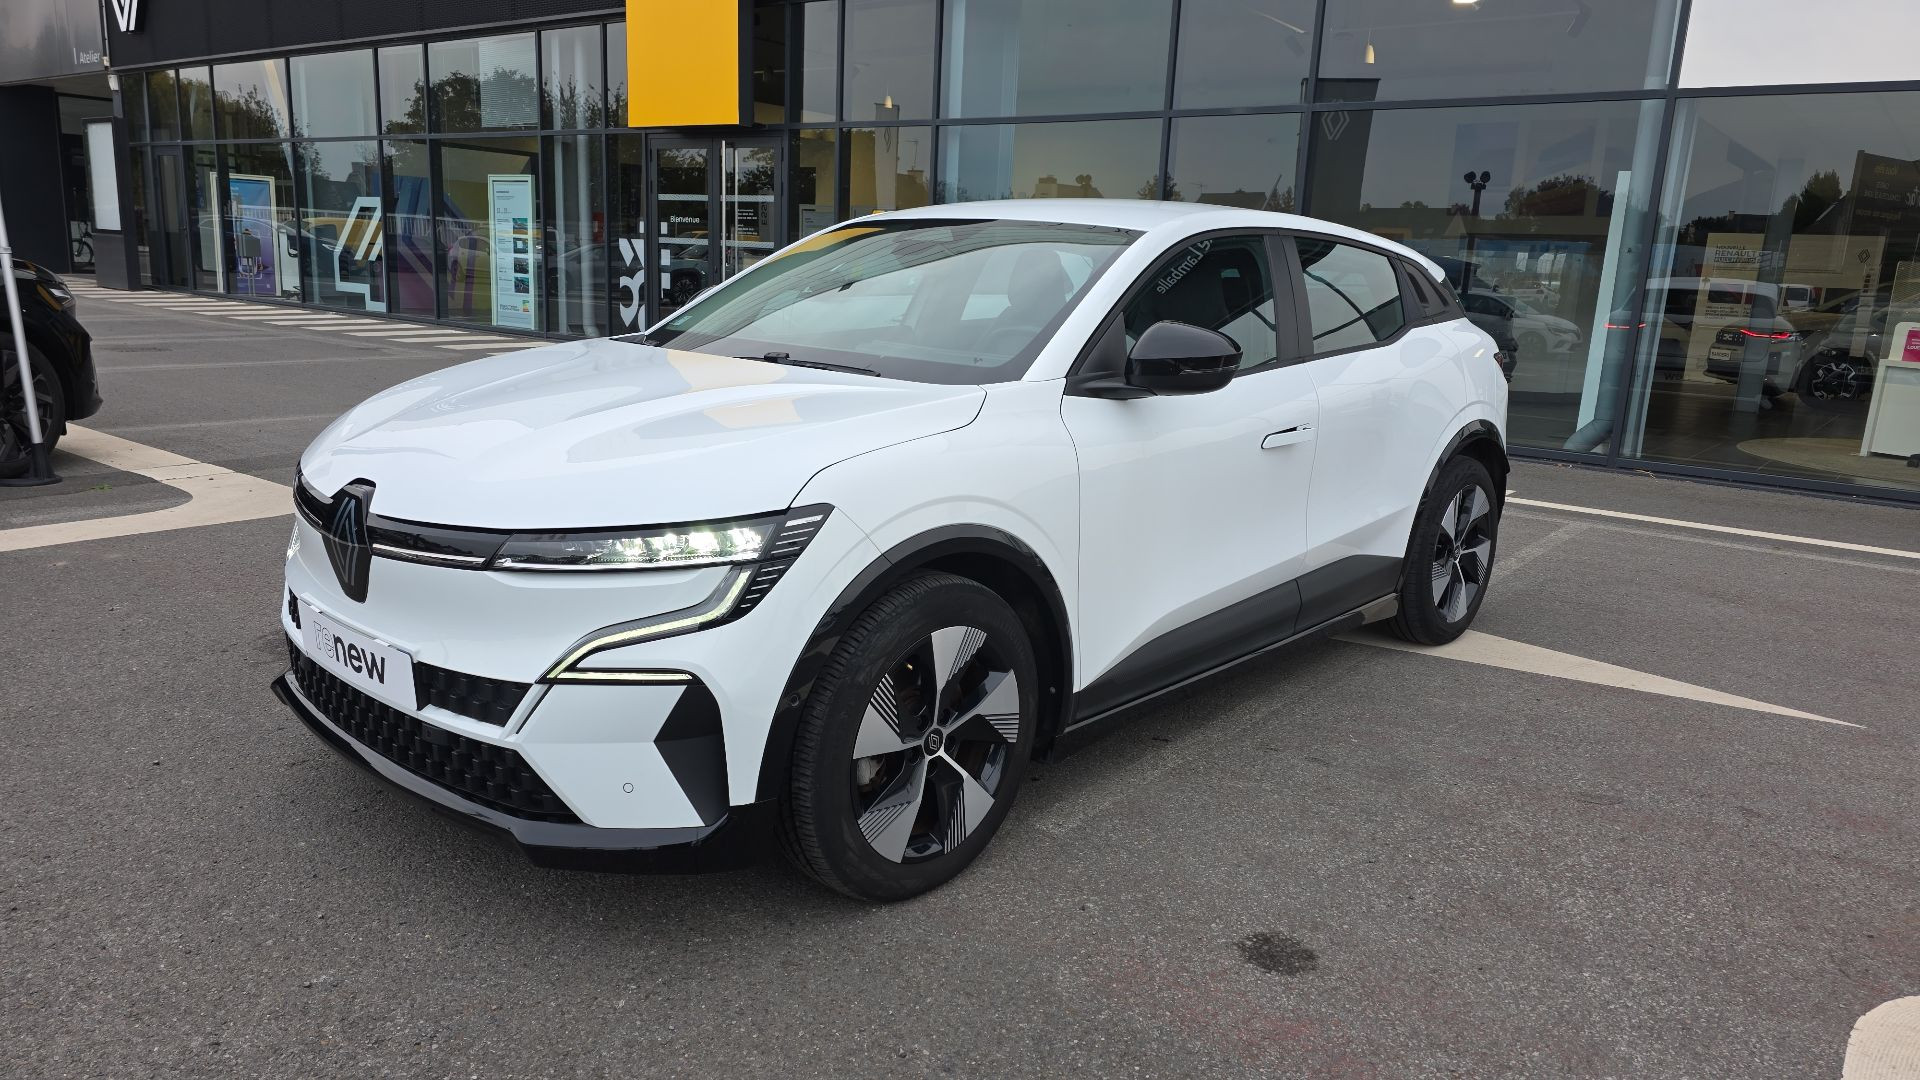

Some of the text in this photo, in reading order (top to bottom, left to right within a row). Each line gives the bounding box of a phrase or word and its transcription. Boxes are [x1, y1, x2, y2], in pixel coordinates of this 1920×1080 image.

[79, 50, 101, 64] Atelier
[670, 214, 700, 224] Bienvenue
[1714, 249, 1756, 258] RENAULT
[313, 620, 386, 685] renew
